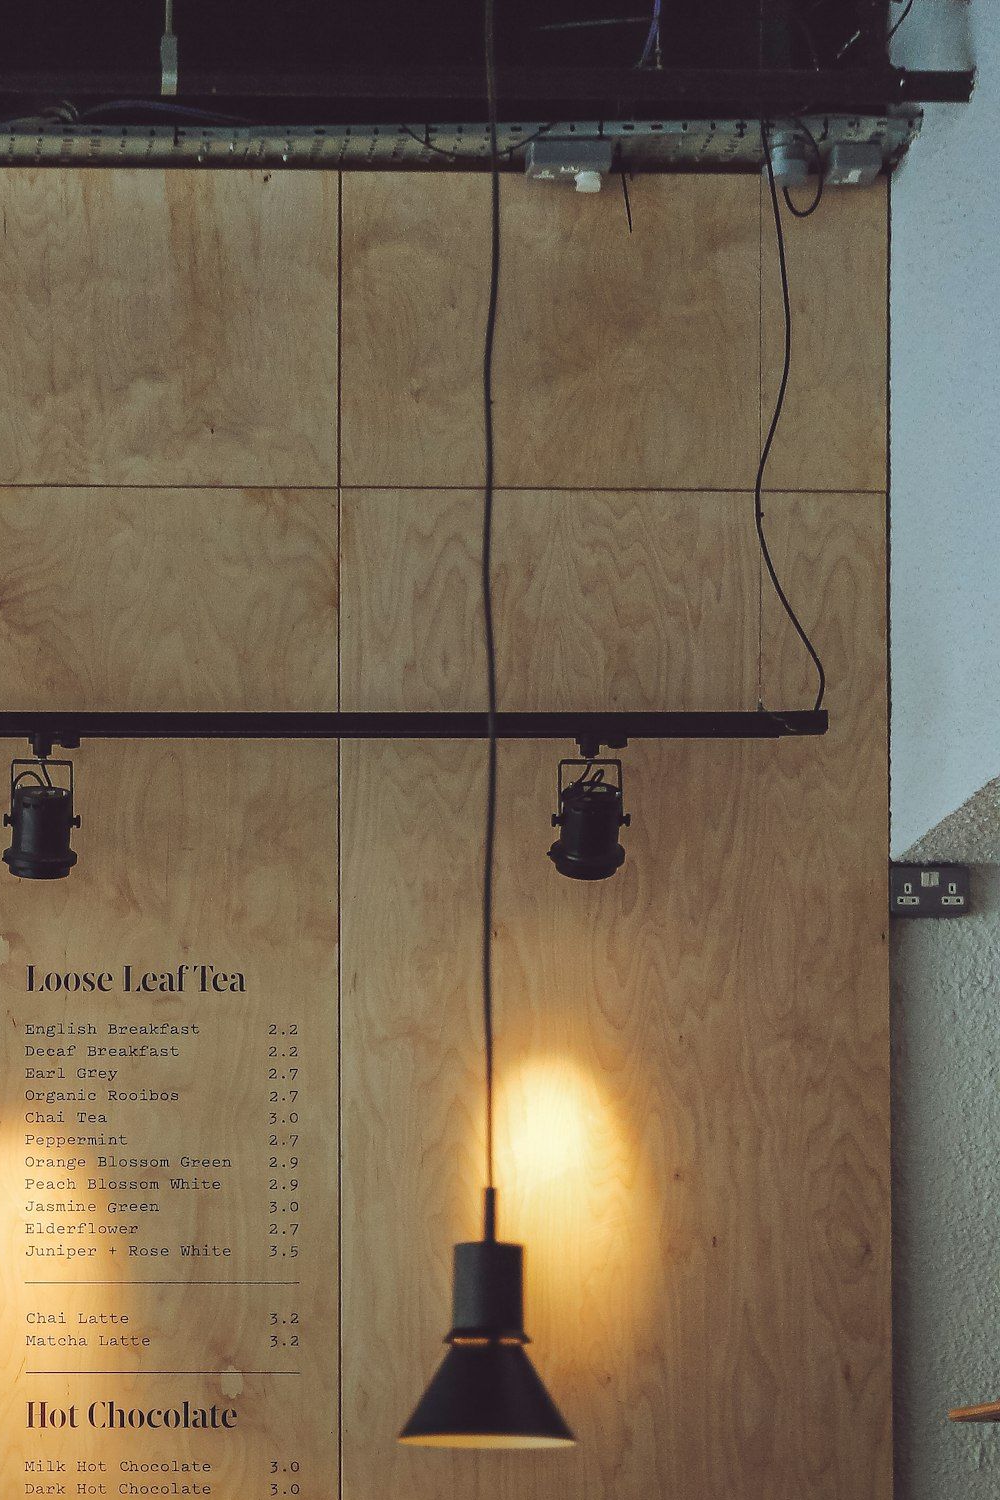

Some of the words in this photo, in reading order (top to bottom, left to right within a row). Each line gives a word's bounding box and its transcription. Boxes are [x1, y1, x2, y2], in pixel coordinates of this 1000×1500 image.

[26, 965, 112, 991] Loose
[123, 965, 189, 992] Leaf
[194, 965, 246, 992] Tea
[25, 1024, 97, 1037] English
[108, 1023, 199, 1034] Breakfast
[269, 1024, 297, 1035] 2.2
[25, 1045, 76, 1056] Decaf
[88, 1046, 179, 1056] Breakfast
[269, 1046, 297, 1056] 2.2
[25, 1068, 65, 1078] Earl
[77, 1068, 117, 1081] Grey
[269, 1068, 298, 1080] 2.7
[26, 1090, 96, 1103] Organic
[108, 1090, 178, 1100] Rooibos
[270, 1091, 298, 1102] 2.7
[26, 1112, 64, 1123] Chai
[77, 1113, 107, 1123] Tea
[270, 1113, 298, 1124] 3.0
[25, 1135, 127, 1148] Peppermint
[270, 1135, 298, 1147] 2.7
[25, 1157, 85, 1170] Orange
[98, 1156, 169, 1167] Blossom
[181, 1157, 231, 1167] Green
[270, 1157, 298, 1169] 2.9
[25, 1178, 76, 1189] Peach
[88, 1179, 159, 1189] Blossom
[170, 1178, 220, 1189] White
[269, 1179, 298, 1191] 2.9
[26, 1201, 96, 1211] Jasmine
[108, 1203, 159, 1213] Green
[270, 1202, 298, 1213] 3.0
[25, 1223, 138, 1234] Elderflower
[269, 1224, 298, 1235] 2.7
[26, 1245, 96, 1259] Juniper
[129, 1246, 169, 1256] Rose
[181, 1245, 231, 1256] White
[269, 1246, 298, 1257] 3.5
[27, 1312, 66, 1323] Chai
[79, 1313, 128, 1323] Latte
[270, 1313, 298, 1325] 3.2
[26, 1335, 88, 1346] Matcha
[99, 1336, 150, 1346] Latte
[271, 1336, 298, 1347] 3.2
[26, 1402, 79, 1428] Hot
[89, 1401, 237, 1428] Chocolate
[25, 1460, 65, 1471] Milk
[77, 1461, 106, 1471] Hot
[120, 1461, 210, 1472] Chocolate
[270, 1462, 299, 1473] 3.0
[25, 1483, 65, 1494] Dark
[77, 1484, 106, 1494] Hot
[119, 1483, 210, 1494] Chocolate
[271, 1484, 299, 1496] 3.0
